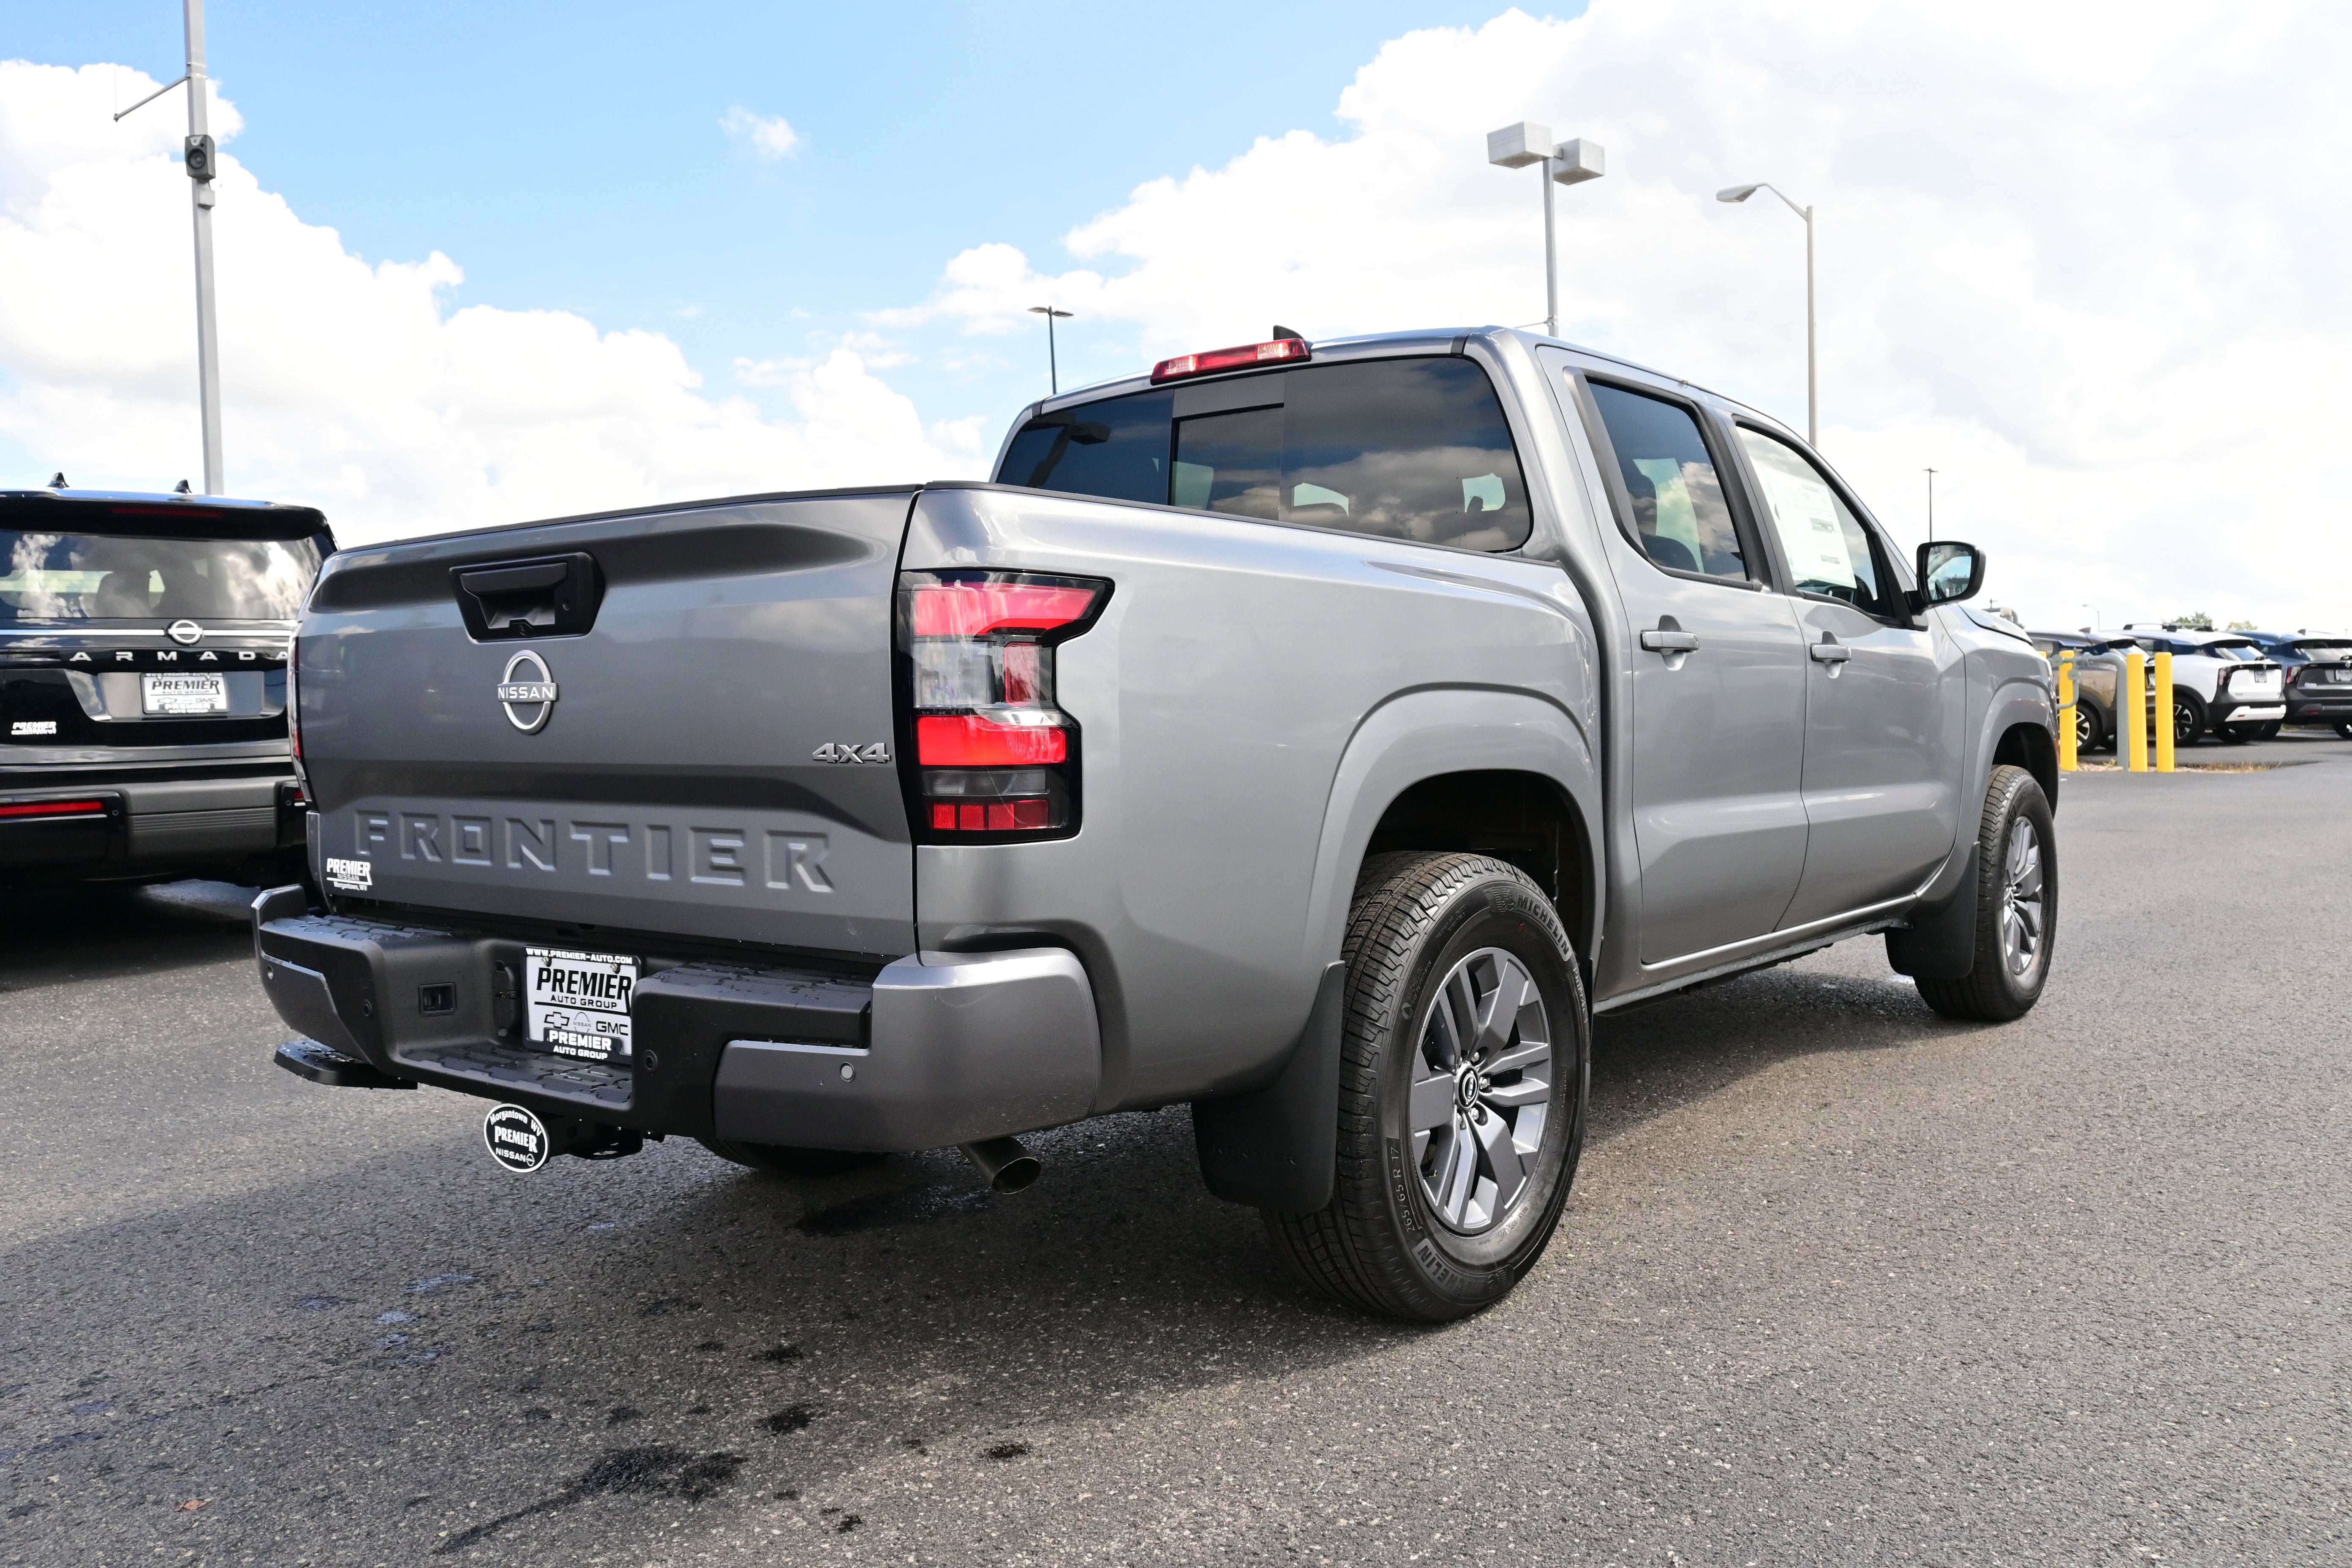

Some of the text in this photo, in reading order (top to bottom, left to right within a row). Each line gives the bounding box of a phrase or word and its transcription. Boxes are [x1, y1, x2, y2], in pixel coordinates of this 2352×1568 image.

[152, 680, 219, 691] PREMIER
[498, 686, 553, 699] NISSAN
[12, 721, 56, 730] PREMIER
[355, 810, 834, 892] FRONTIER
[327, 858, 371, 879] PREMIER
[1518, 893, 1570, 955] MICHELIN
[525, 948, 632, 964] WWW.PREMIER-AUTO.COM
[536, 967, 632, 1006] PREMIER
[550, 995, 617, 1009] AUTO GROUP
[596, 1021, 629, 1036] GMC
[549, 1030, 612, 1051] PREMIER
[553, 1045, 608, 1060] AUTO GROUP
[490, 1110, 542, 1136] Morgantown WV
[494, 1125, 538, 1153] PREMIER
[495, 1147, 526, 1162] NISSAN
[1391, 1147, 1415, 1233] 265/65 R 17
